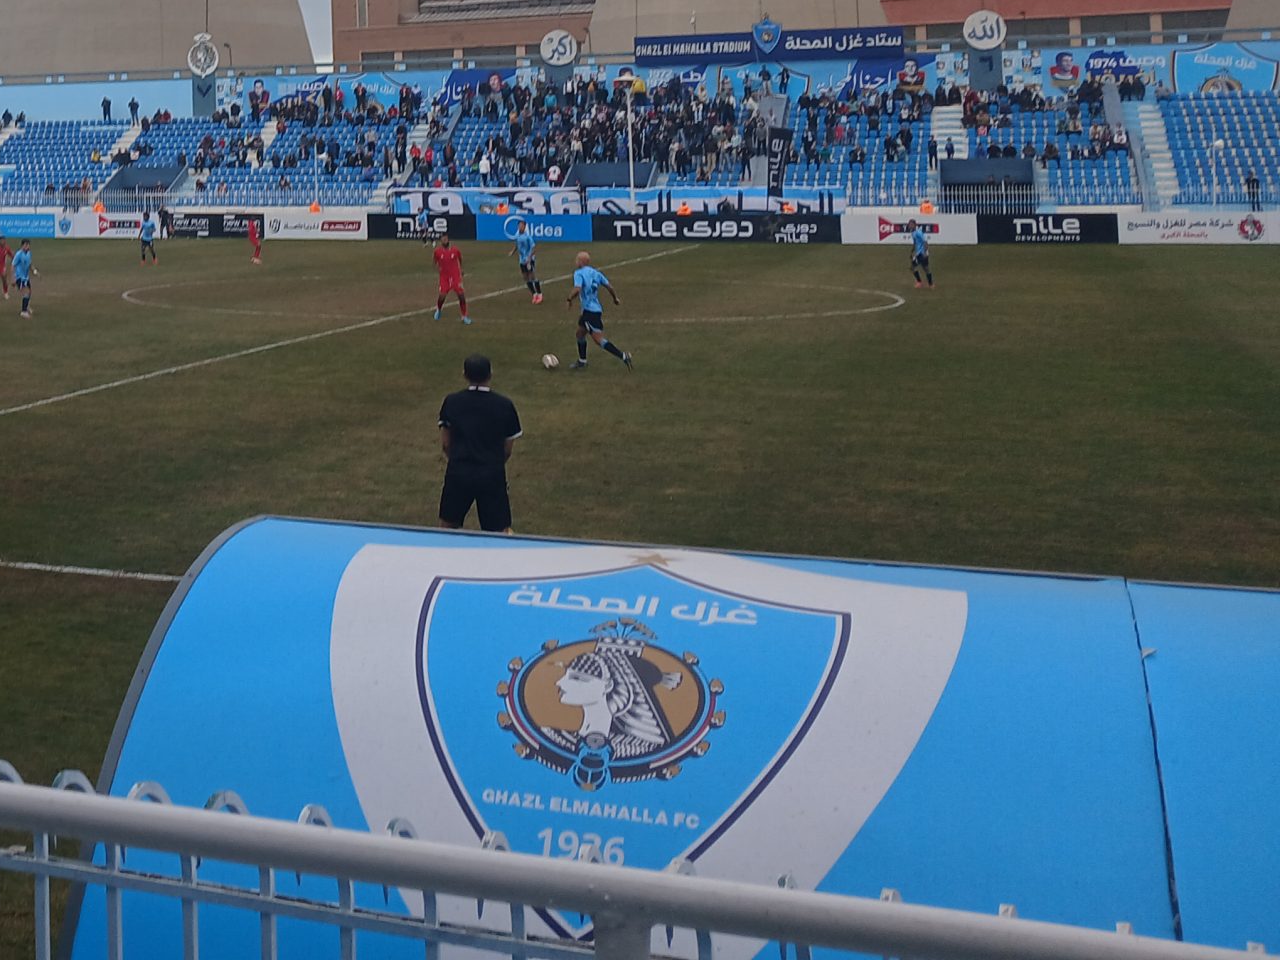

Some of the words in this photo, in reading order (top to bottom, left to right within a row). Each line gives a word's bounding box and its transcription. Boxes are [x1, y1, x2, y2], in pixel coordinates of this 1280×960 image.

[672, 40, 711, 55] MAHALLA
[712, 40, 751, 53] STADIUM
[784, 36, 832, 50] المحلة
[835, 32, 864, 51] غزل
[865, 33, 902, 47] ستاد
[1088, 57, 1118, 69] 1974
[1015, 234, 1080, 242] DEVELOPMENTS
[507, 584, 660, 617] المحلة
[671, 601, 758, 626] غزل
[482, 788, 545, 810] GHAZL
[549, 797, 669, 826] ELMAHALLA
[673, 812, 700, 830] FC
